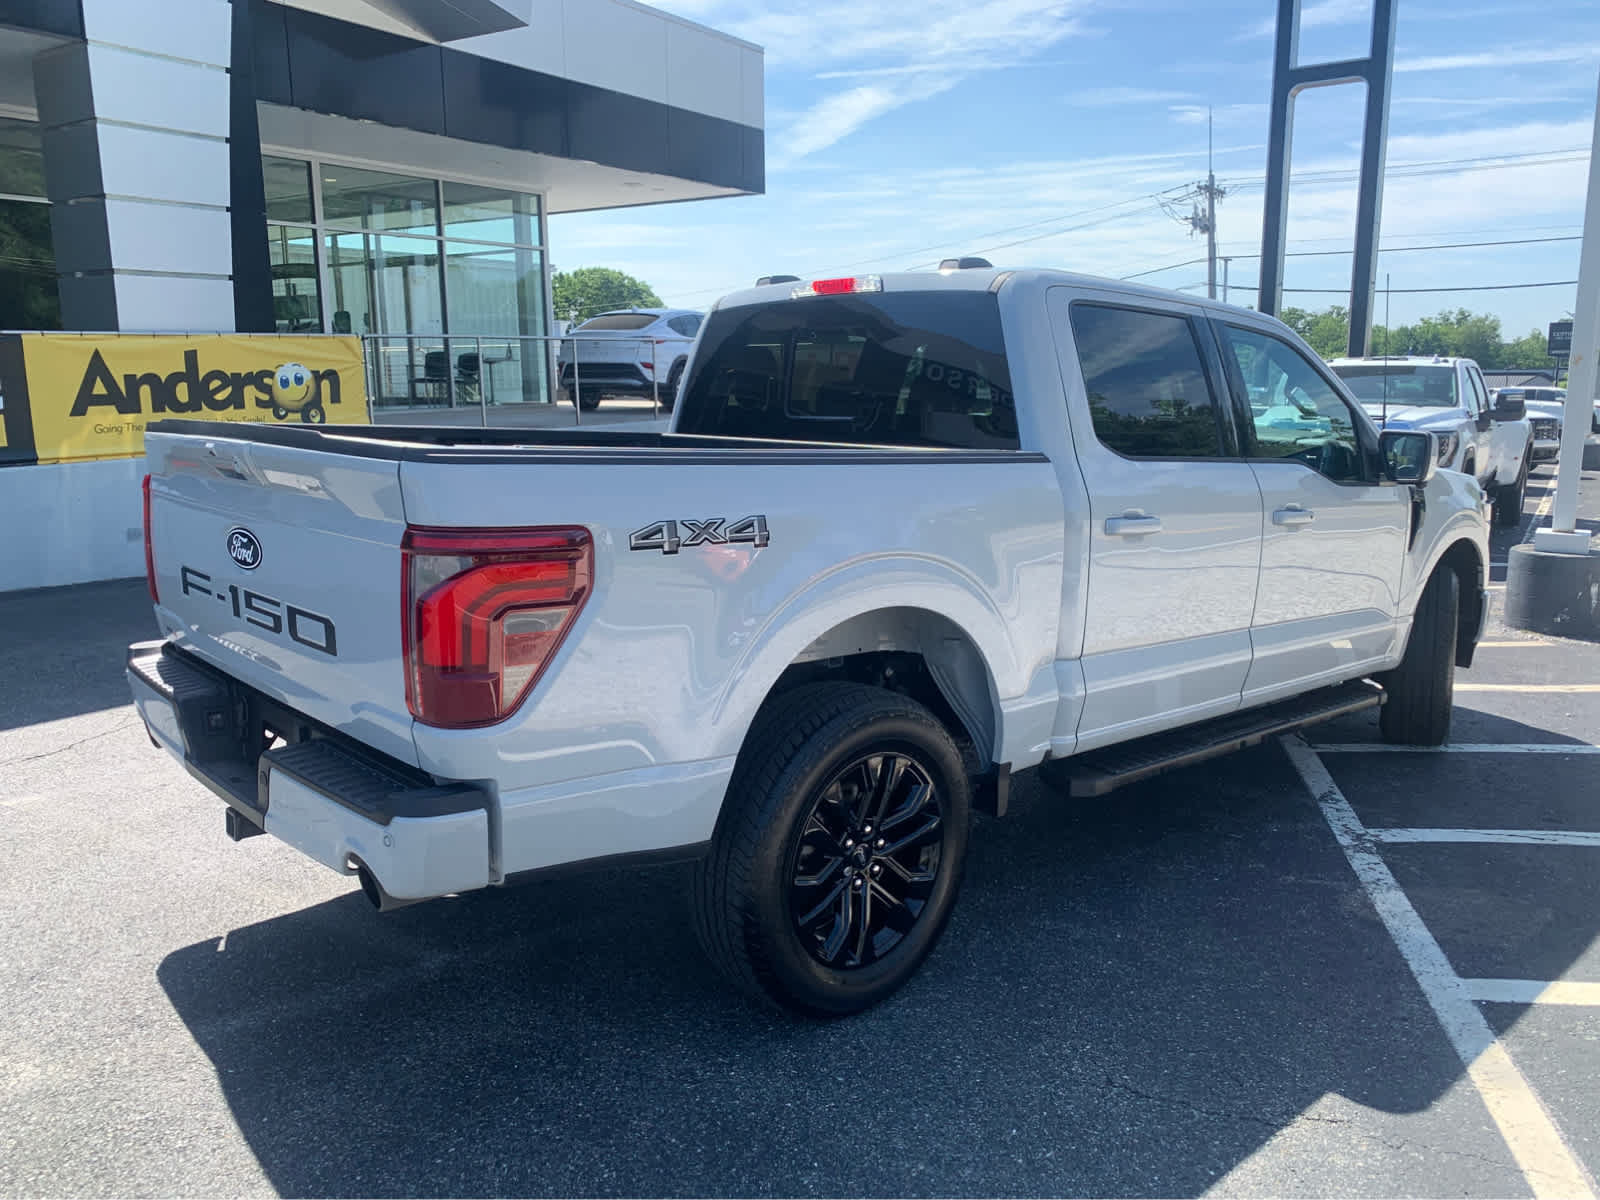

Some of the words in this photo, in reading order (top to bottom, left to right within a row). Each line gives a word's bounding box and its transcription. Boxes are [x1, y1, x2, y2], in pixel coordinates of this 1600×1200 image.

[69, 348, 341, 418] Anderson
[95, 423, 123, 434] Going
[125, 422, 144, 431] The
[230, 532, 256, 565] Ford
[181, 565, 337, 656] F-150
